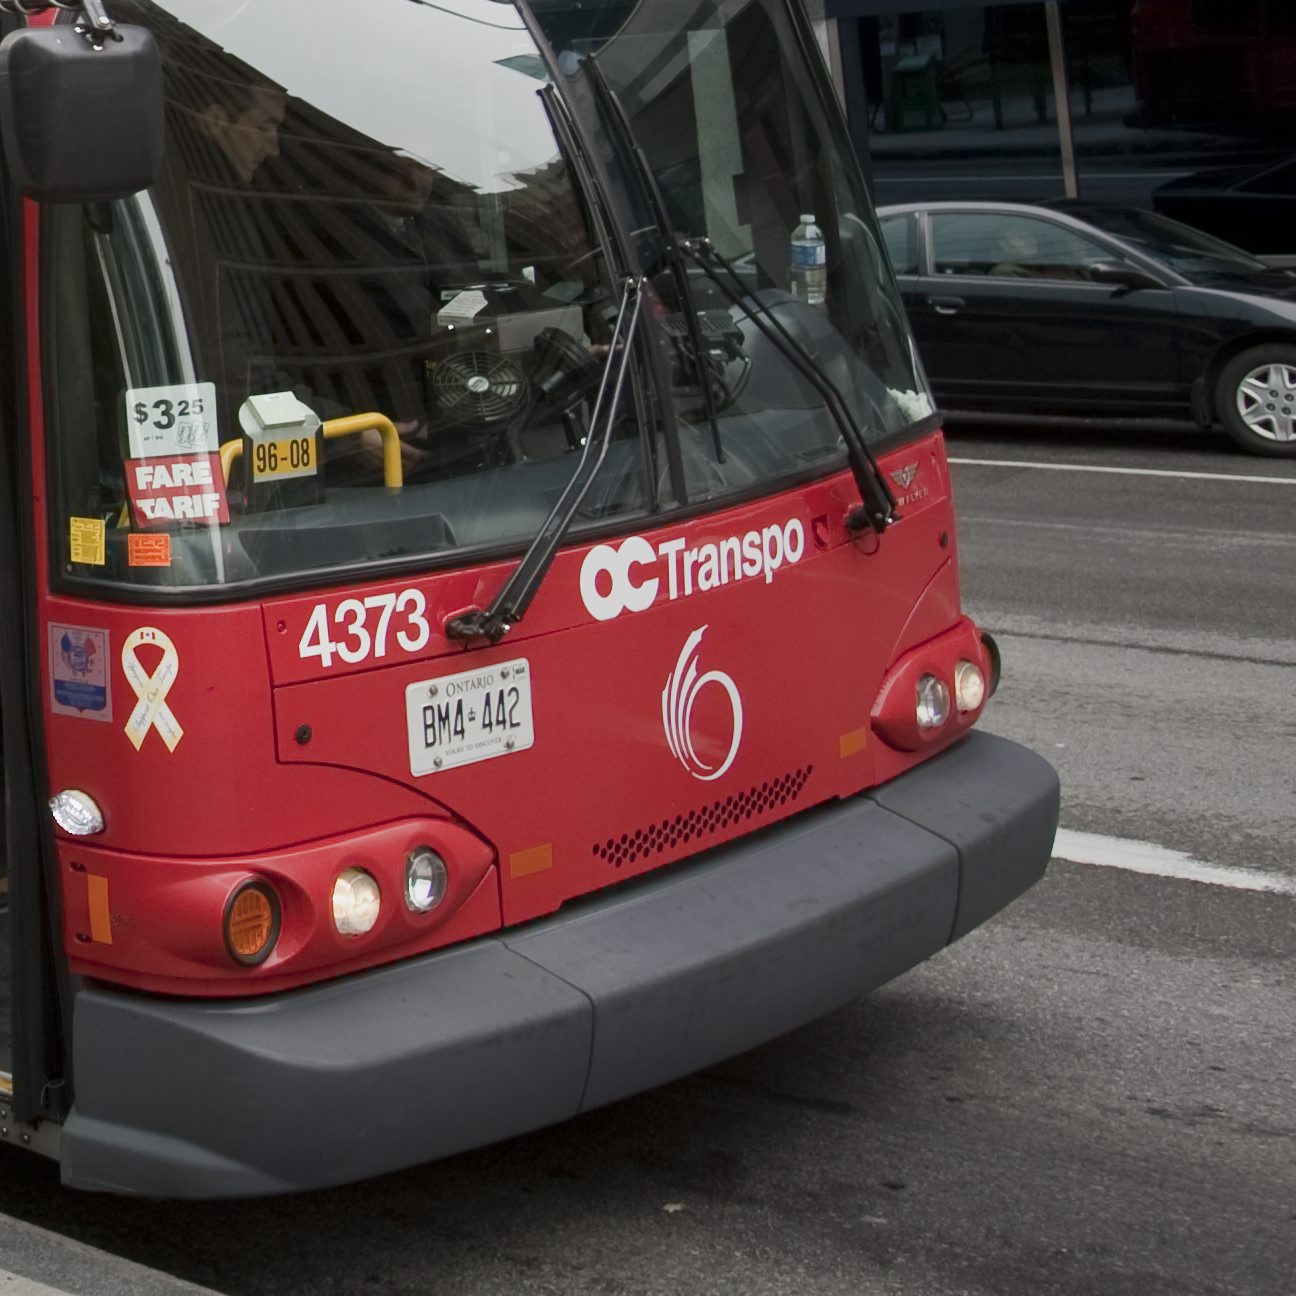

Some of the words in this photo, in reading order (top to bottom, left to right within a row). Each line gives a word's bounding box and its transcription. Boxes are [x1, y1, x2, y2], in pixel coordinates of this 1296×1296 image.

[256, 438, 311, 474] 96-08
[135, 461, 213, 491] FARE
[136, 493, 220, 520] TARIF
[580, 535, 658, 622] OC
[658, 517, 805, 598] Transpo
[298, 588, 430, 668] 4373
[445, 674, 495, 698] ONTARIO
[422, 698, 466, 749] BM4
[482, 686, 522, 735] 442
